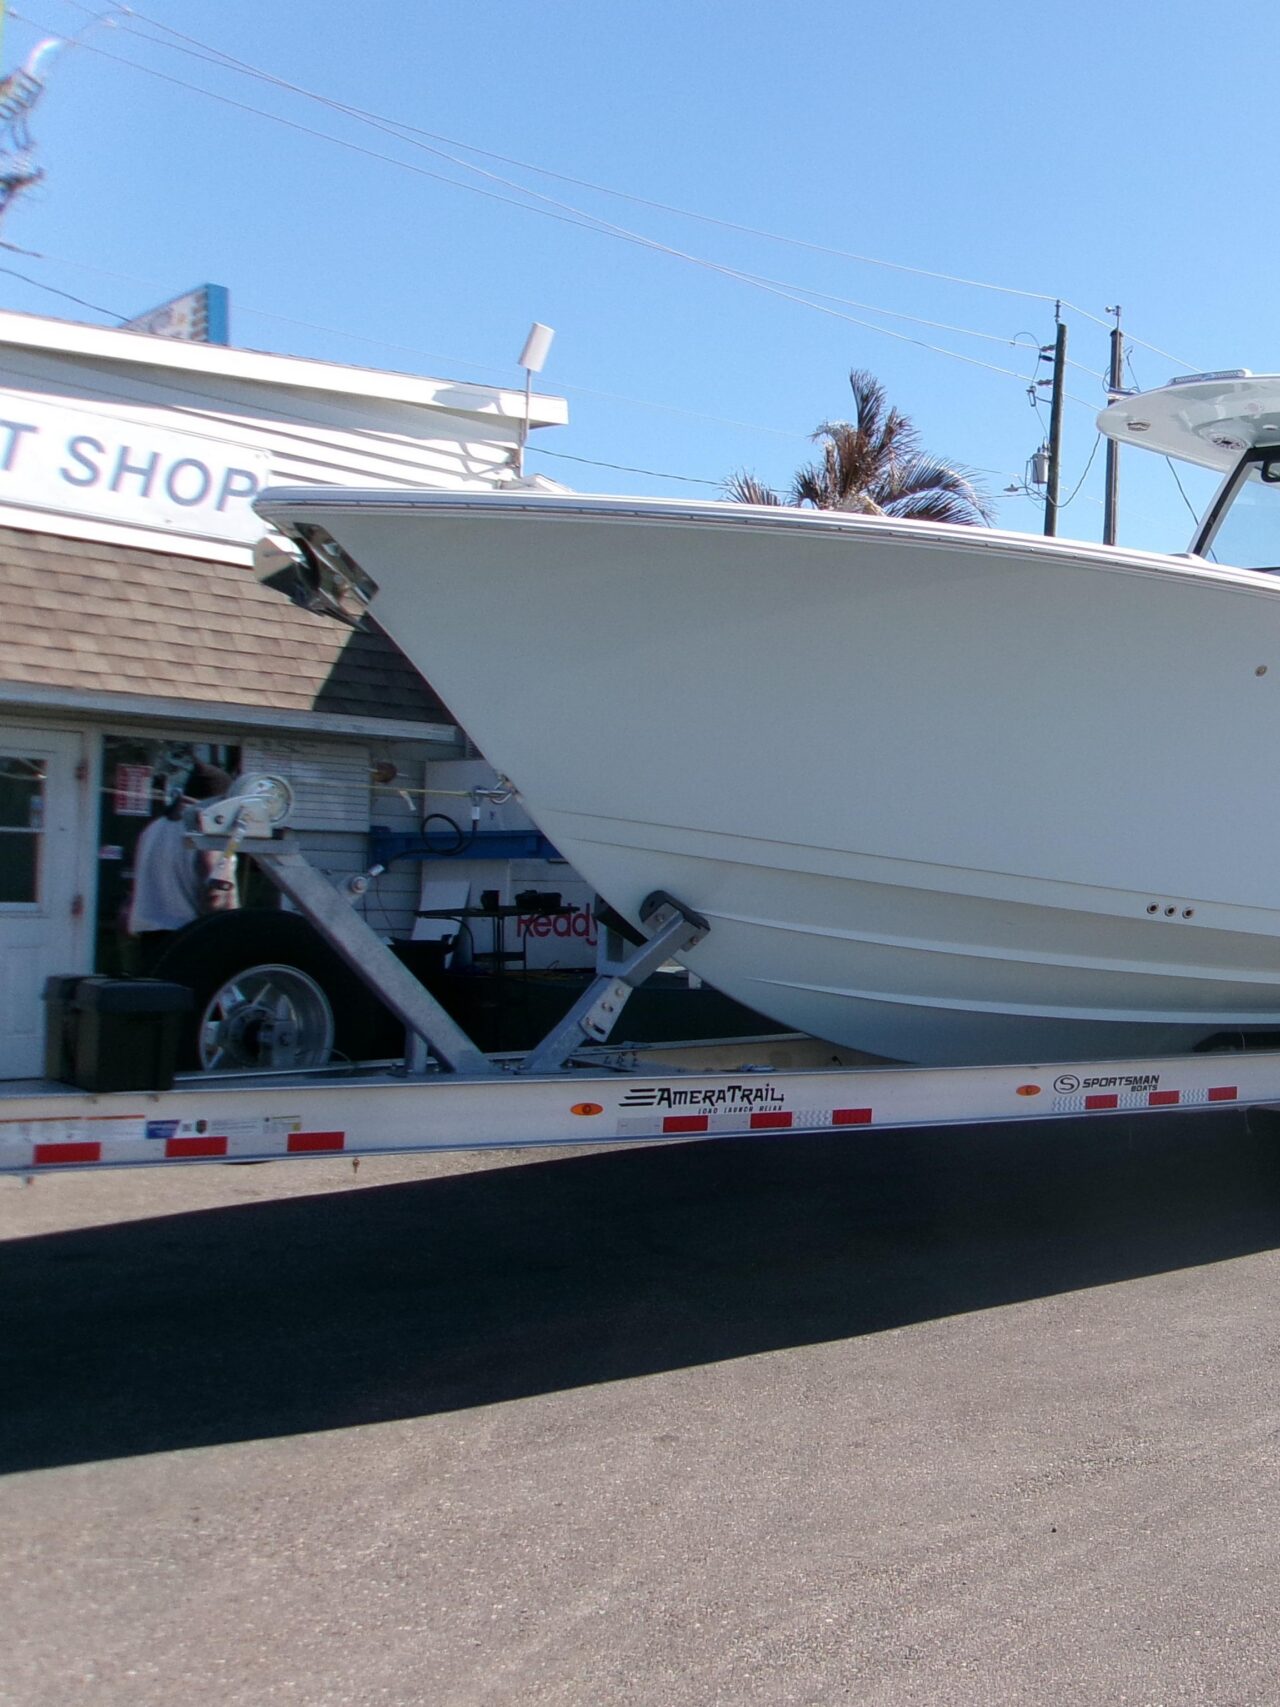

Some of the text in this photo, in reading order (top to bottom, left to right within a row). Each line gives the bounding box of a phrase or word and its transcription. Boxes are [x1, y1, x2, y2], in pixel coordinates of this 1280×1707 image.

[59, 435, 259, 512] SHOP
[1082, 1075, 1160, 1088] SPORTSMAN
[1131, 1084, 1158, 1093] BOATS
[724, 1105, 753, 1114] LAUNCH
